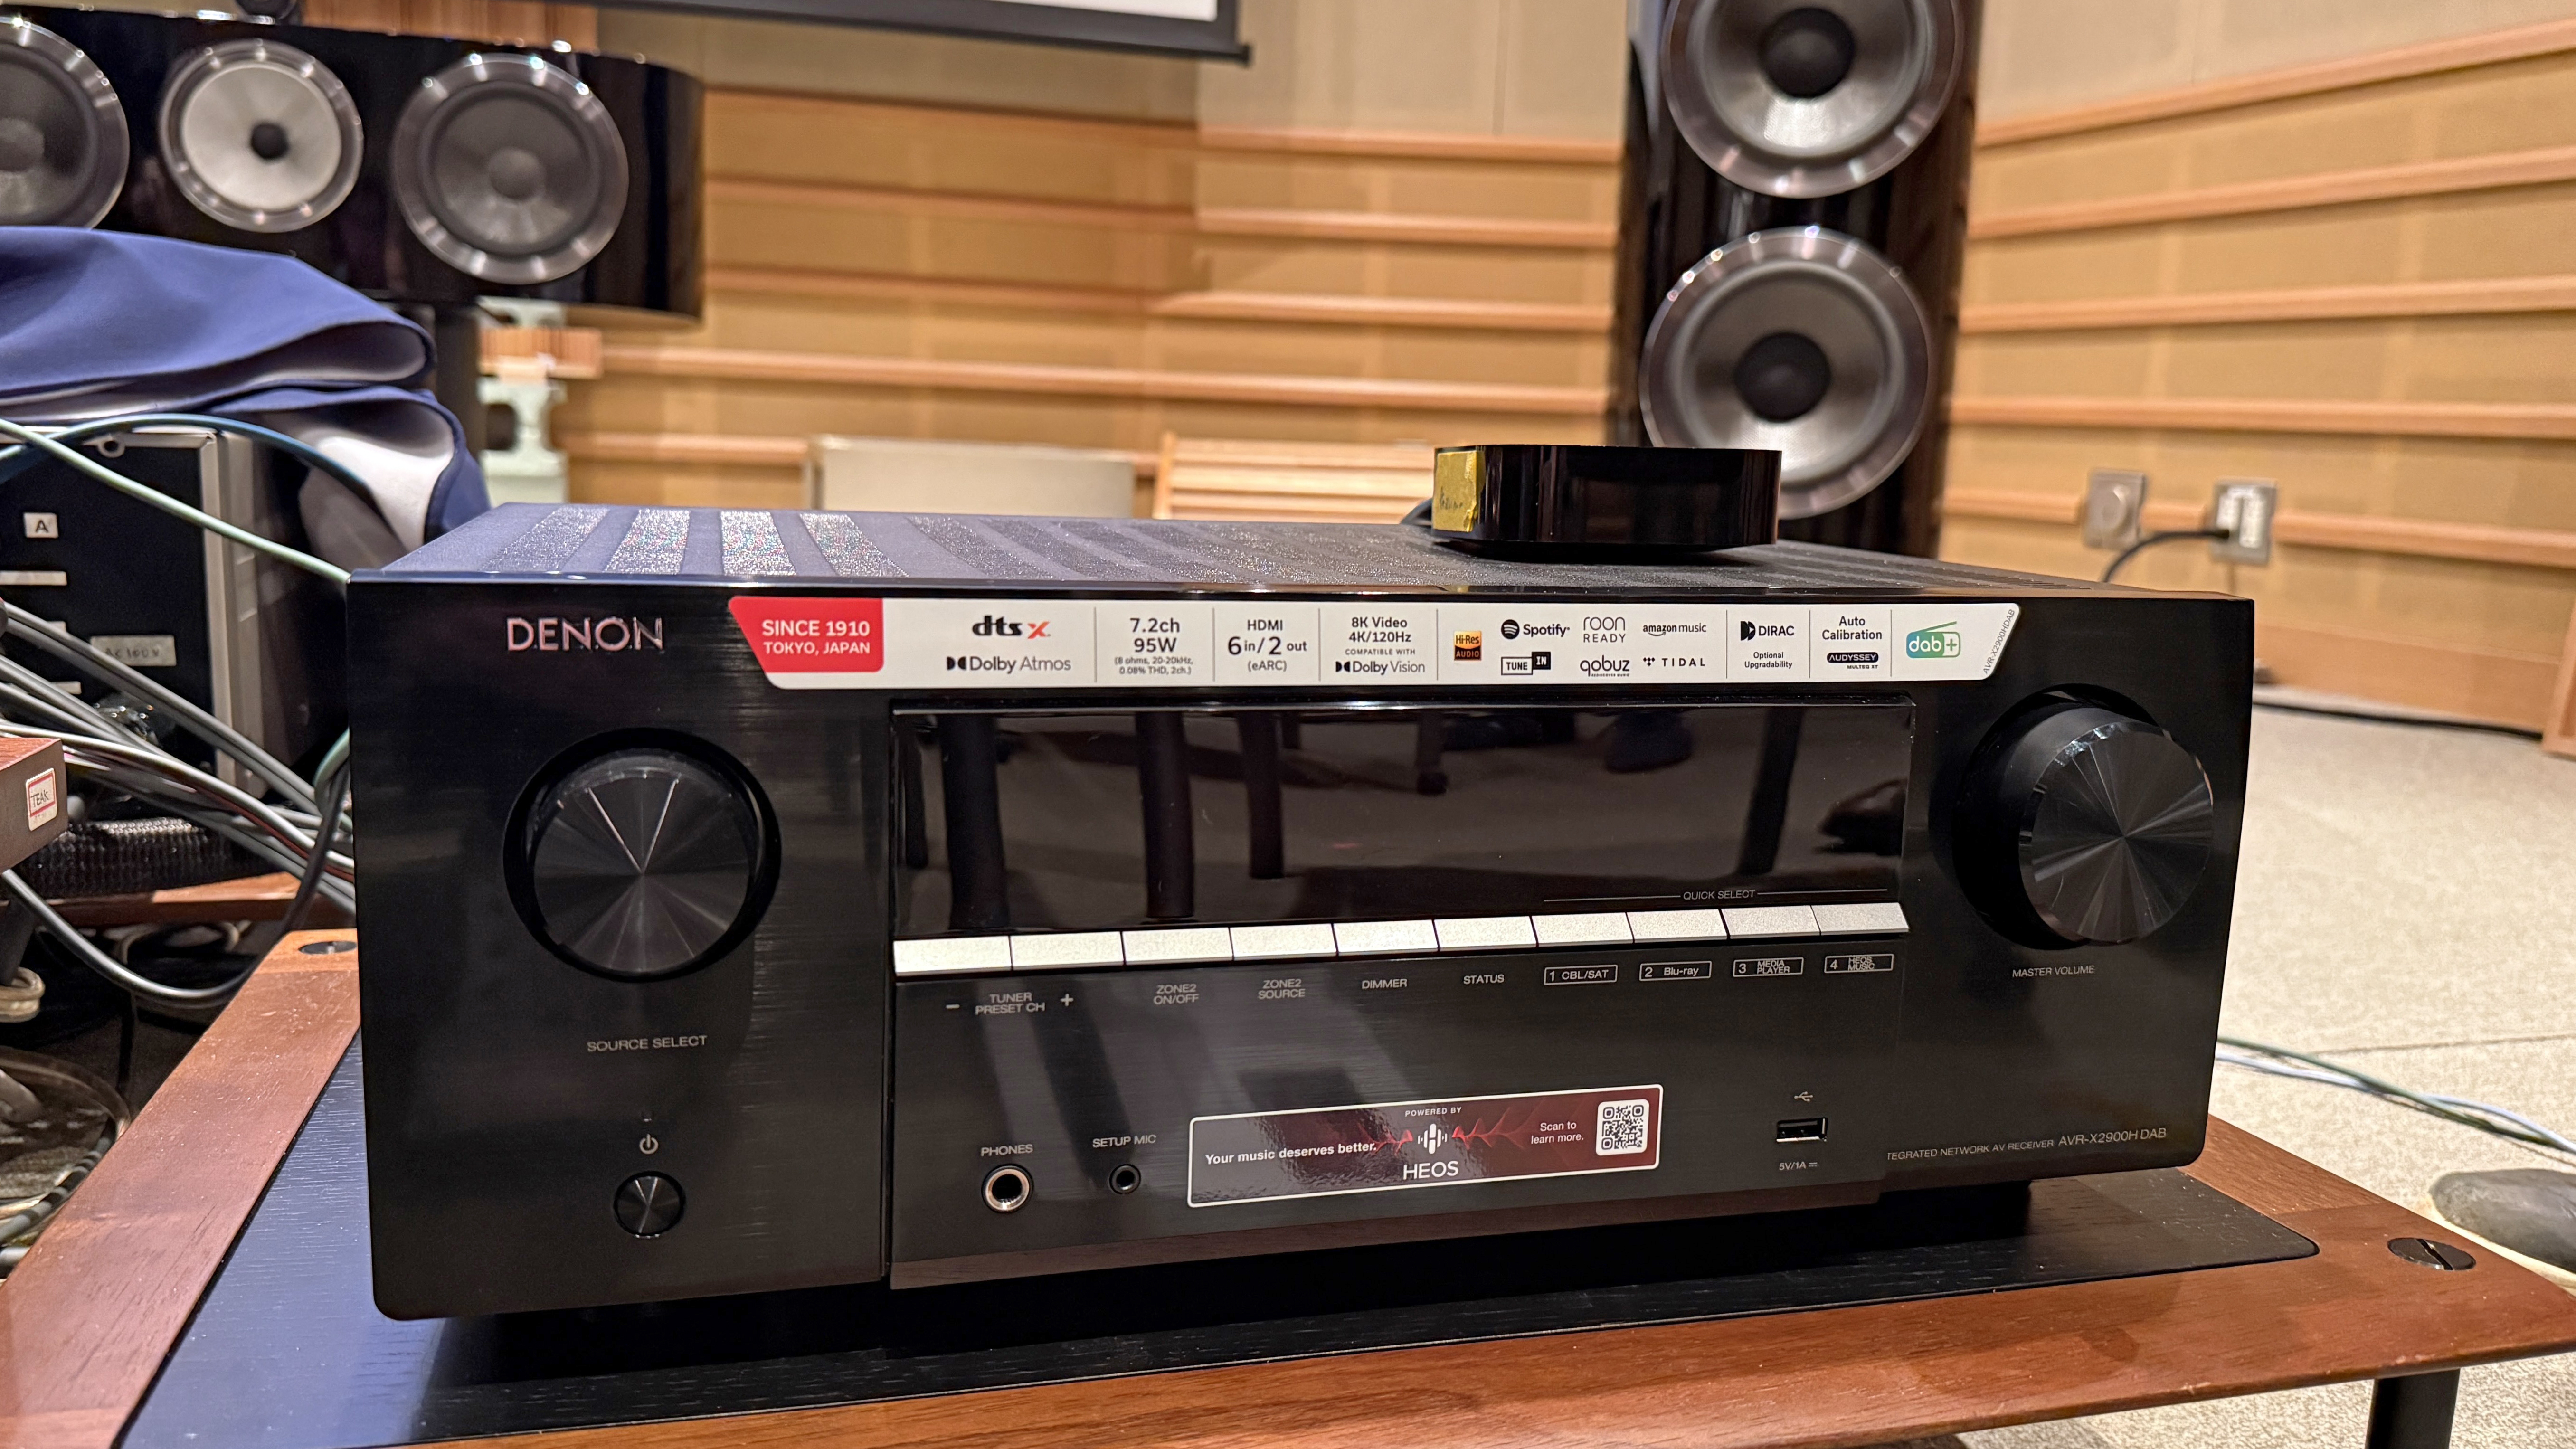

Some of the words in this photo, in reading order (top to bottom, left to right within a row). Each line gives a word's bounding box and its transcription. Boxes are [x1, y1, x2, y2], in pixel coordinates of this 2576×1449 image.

[35, 520, 49, 533] A
[1130, 617, 1180, 632] 7.2ch
[1247, 620, 1283, 631] HDMI
[1352, 617, 1368, 628] 8K
[1372, 617, 1408, 628] Video
[1583, 616, 1626, 631] roon
[1839, 616, 1866, 627] Auto
[762, 620, 820, 637] SINCE
[826, 620, 870, 636] 1910
[1523, 624, 1567, 637] Spotify
[1678, 623, 1707, 633] music
[1759, 625, 1795, 636] DIRAC
[506, 616, 663, 652] DENON
[1349, 632, 1411, 643] 4K/120Hz
[1583, 634, 1626, 643] READY
[1822, 629, 1882, 640] Calibration
[1134, 637, 1177, 653] 95W
[1455, 635, 1479, 645] Hi-Res
[1983, 609, 2015, 675] AVR-X2900HDAB
[763, 641, 820, 656] TOKYO,
[823, 641, 870, 654] JAPAN
[1287, 641, 1307, 651] out
[1753, 652, 1784, 660] Optional
[971, 657, 1016, 674] Dolby
[1020, 656, 1071, 671] Atmos
[1248, 661, 1287, 672] (eARC)
[1353, 661, 1388, 675] Dolby
[1390, 661, 1425, 672] Vision
[1506, 662, 1528, 670] TUNE
[1536, 656, 1547, 665] IN
[1580, 654, 1630, 677] qobuz
[1662, 658, 1705, 667] TIDAL
[1744, 661, 1793, 669] Upgradability
[30, 790, 49, 807] TEAK
[1683, 891, 1715, 900] QUICK
[1717, 890, 1756, 899] SELECT
[1738, 963, 1746, 974] 3
[1757, 959, 1785, 967] MEDIA
[1830, 959, 1838, 969] 4
[1549, 971, 1555, 982] 1
[1562, 969, 1609, 980] CBL/SAT
[1644, 967, 1653, 978] 2
[1664, 966, 1699, 978] Blu-ray
[1757, 966, 1790, 975] PLAYER
[2012, 967, 2052, 977] MASTER
[2054, 965, 2095, 975] VOLUME
[1263, 979, 1302, 989] ZONE2
[1362, 978, 1408, 990] DIMMER
[1463, 974, 1505, 985] STATUS
[1156, 984, 1197, 994] ZONE2
[1258, 988, 1306, 999] SOURCE
[990, 992, 1032, 1004] TUNER
[1153, 994, 1199, 1005] ON/OFF
[975, 1004, 1023, 1015] PRESET
[1025, 1002, 1045, 1013] CH
[587, 1039, 649, 1052] SOURCE
[653, 1035, 708, 1048] SELECT
[1404, 1108, 1447, 1117] POWERED
[1540, 1122, 1564, 1132] Scan
[1567, 1121, 1577, 1130] to
[1092, 1136, 1131, 1148] SETUP
[1134, 1135, 1157, 1145] MIC
[1531, 1134, 1556, 1145] learn
[1557, 1134, 1584, 1143] more.
[1941, 1144, 1989, 1156] NETWORK
[1992, 1143, 2006, 1152] AV
[2008, 1139, 2054, 1151] RECEIVER
[2058, 1130, 2138, 1146] AVR-X2900H
[2140, 1127, 2167, 1139] DAB
[980, 1144, 1033, 1157] PHONES
[1205, 1154, 1234, 1165] Your
[1237, 1149, 1275, 1162] music
[1279, 1146, 1335, 1159] deserves
[1338, 1142, 1377, 1153] better.
[1402, 1160, 1459, 1180] HEOS
[1779, 1161, 1806, 1171] 5V/1A
